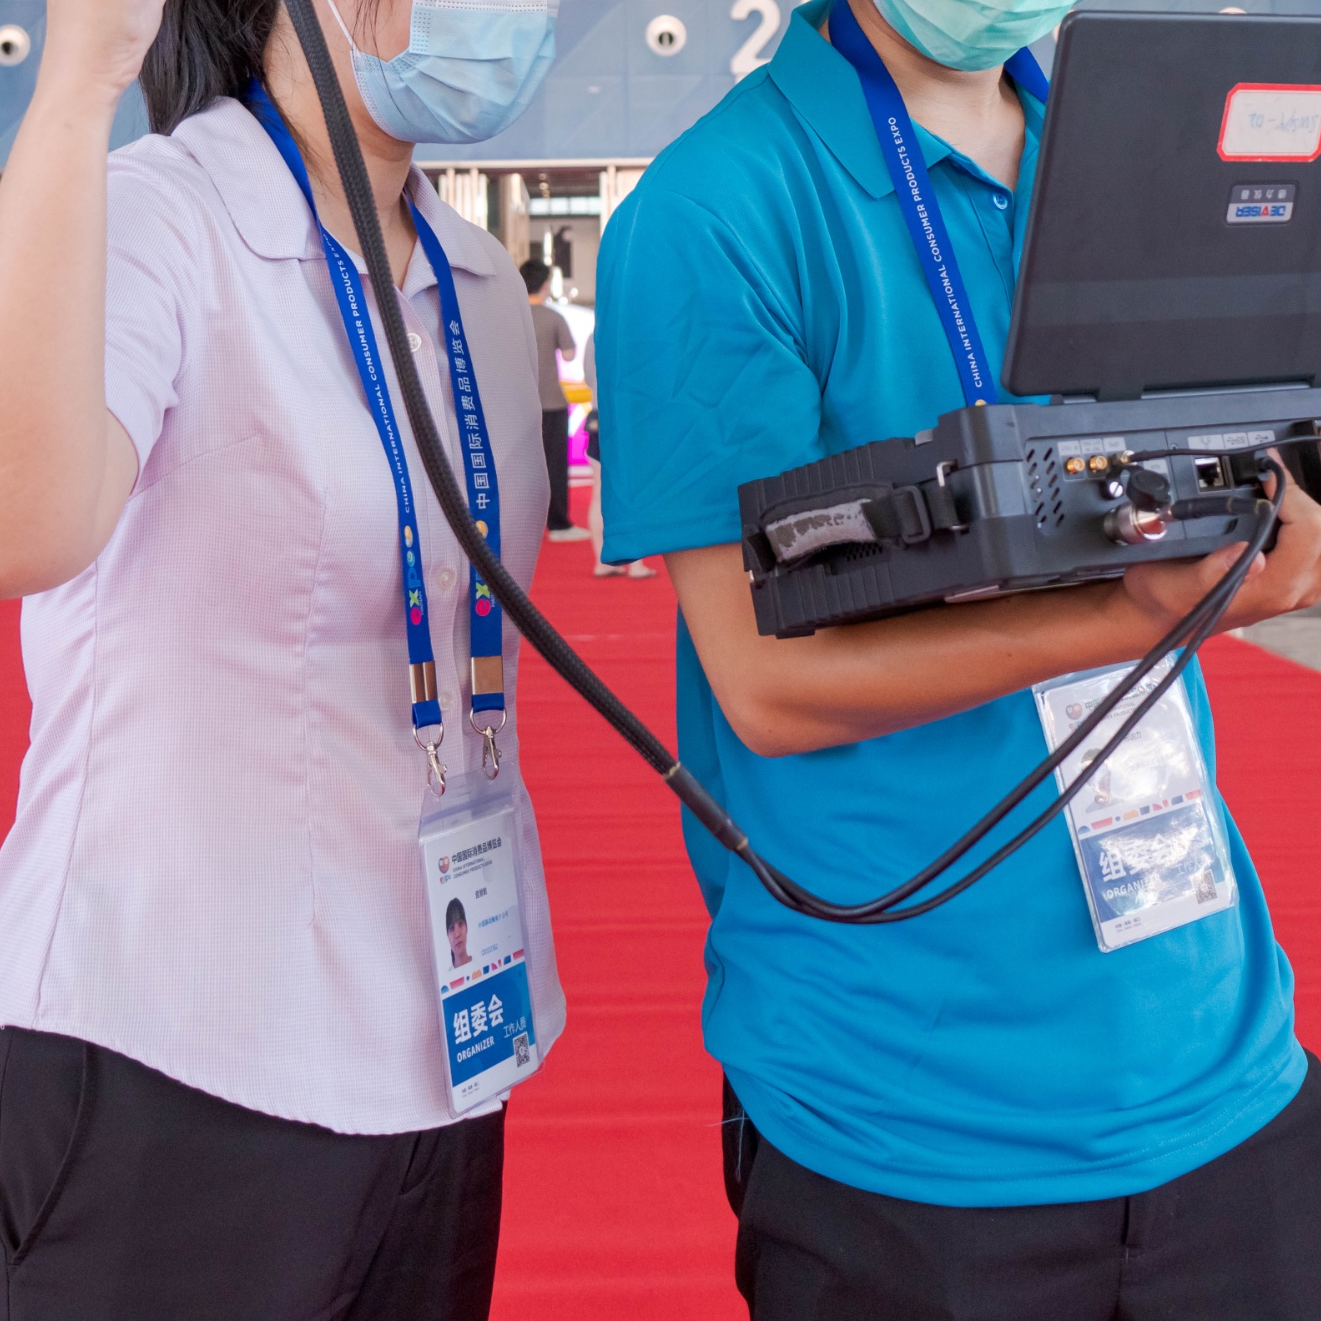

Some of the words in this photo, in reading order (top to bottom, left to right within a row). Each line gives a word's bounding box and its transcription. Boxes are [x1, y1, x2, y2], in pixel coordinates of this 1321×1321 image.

[888, 116, 904, 145] EXPO
[897, 146, 923, 202] PRODUCTS
[916, 204, 943, 262] CONSUMER
[1234, 205, 1287, 218] DEVISER
[337, 260, 360, 317] PRODUCTS
[938, 264, 972, 351] INTERNATIONAL
[355, 320, 377, 381] CONSUMER
[967, 352, 983, 388] CHINA
[374, 383, 403, 474] INTERNATIONAL
[449, 319, 491, 510] 中国国际消费品博览会
[399, 476, 411, 514] CHINA
[406, 550, 422, 625] expo
[452, 992, 505, 1046] 组委会
[503, 1016, 527, 1040] 工作人员
[456, 1035, 496, 1064] ORGANIZER
